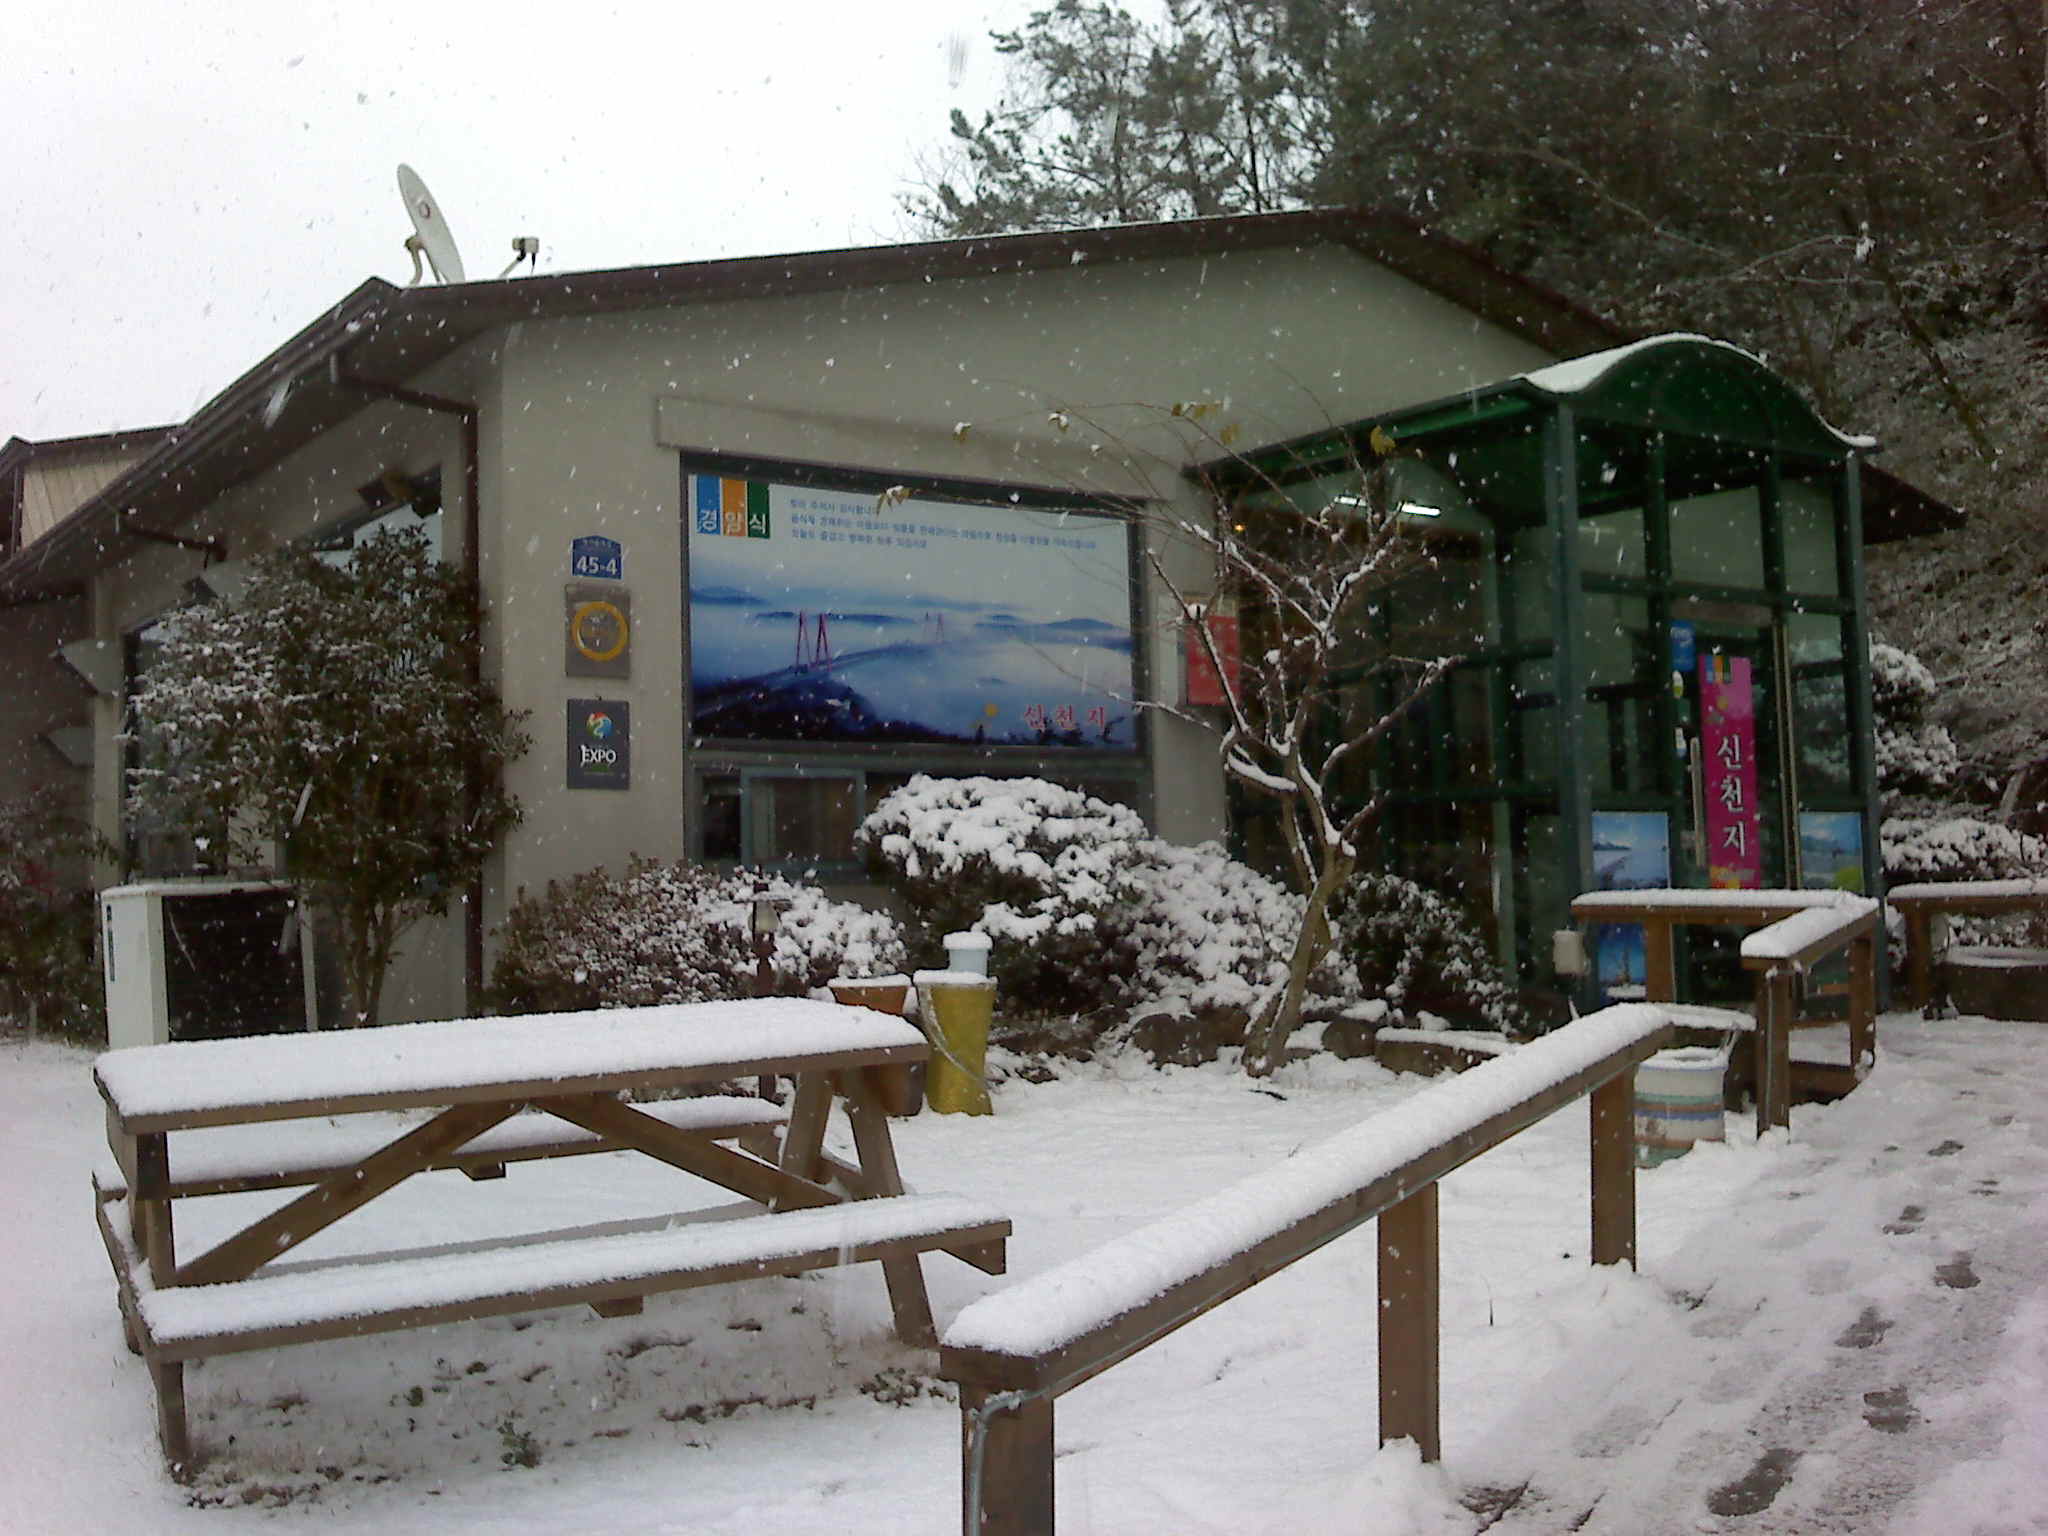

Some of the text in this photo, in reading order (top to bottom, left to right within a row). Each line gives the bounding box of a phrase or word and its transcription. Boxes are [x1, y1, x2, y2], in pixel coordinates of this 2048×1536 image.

[576, 555, 618, 576] 45-4
[580, 744, 617, 767] EXPO
[1717, 735, 1746, 857] 신천지
